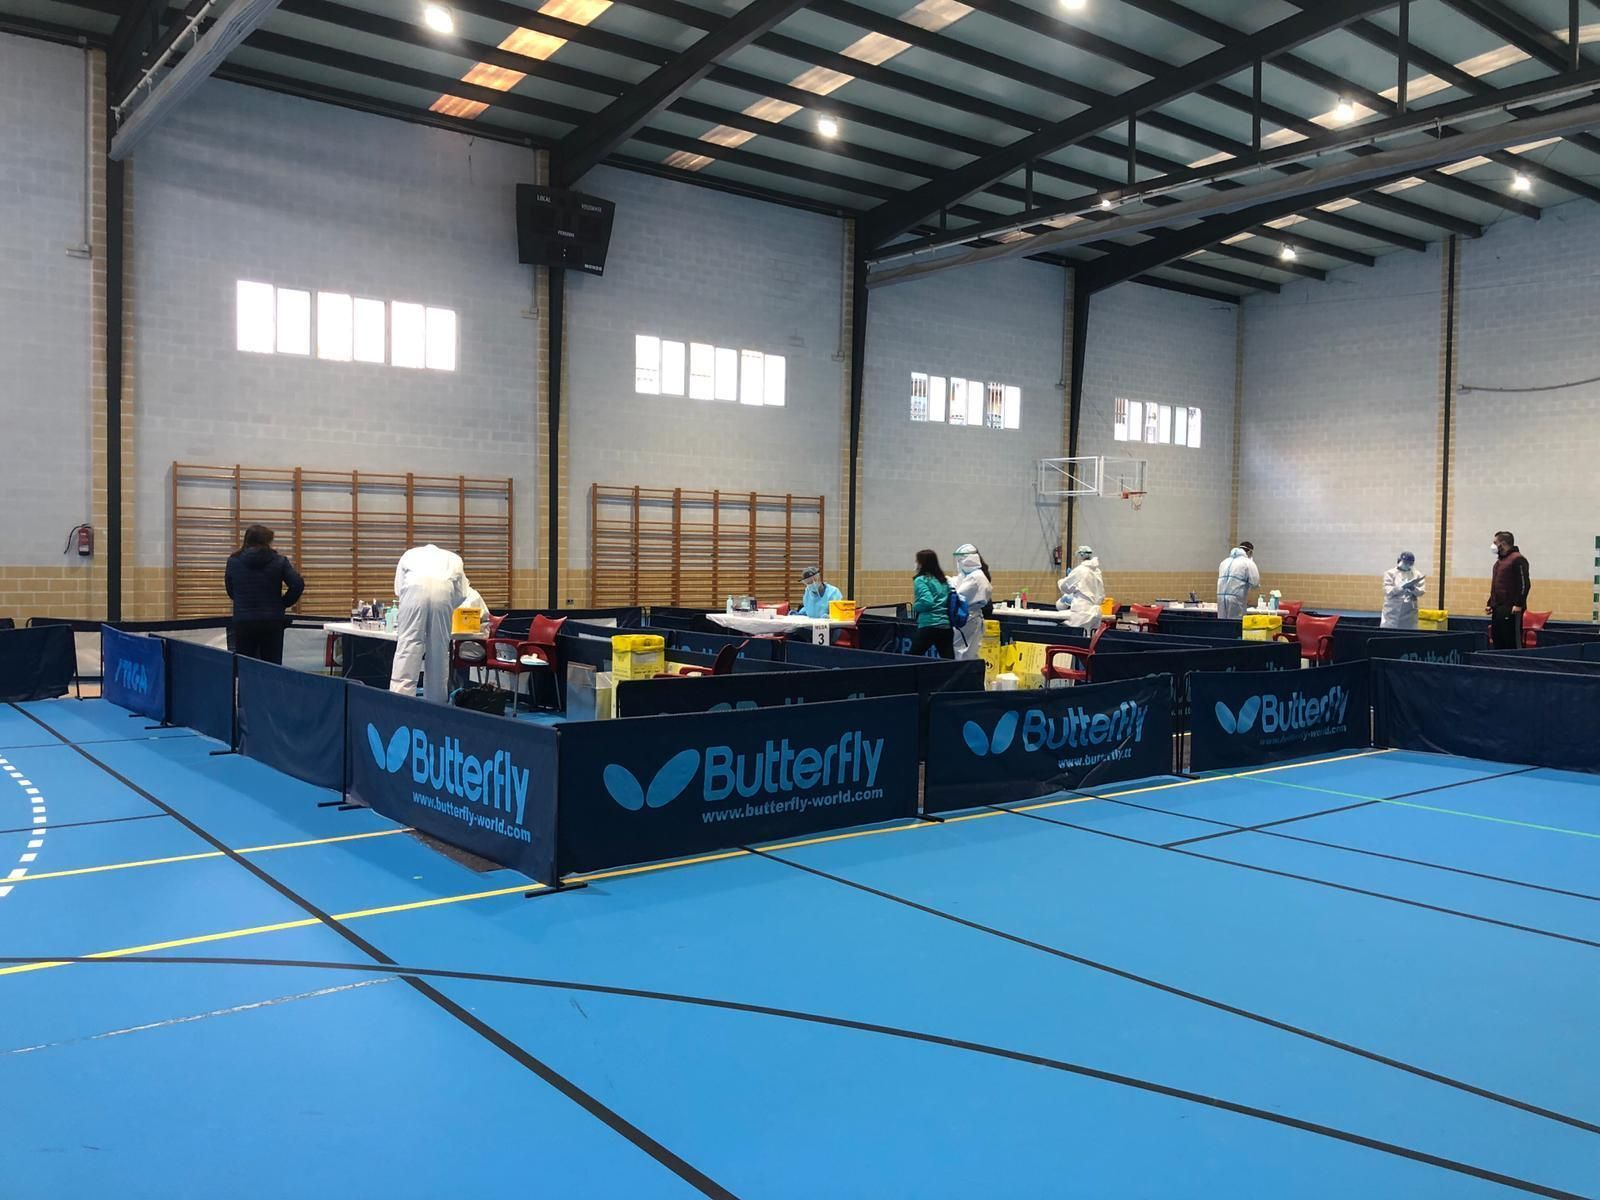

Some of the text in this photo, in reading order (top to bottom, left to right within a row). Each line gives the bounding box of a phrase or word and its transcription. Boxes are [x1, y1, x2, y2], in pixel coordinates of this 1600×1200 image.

[818, 633, 824, 645] 3
[1022, 700, 1148, 752] Butterfly
[412, 728, 529, 825] Butterfly
[703, 730, 884, 802] Butterfly
[412, 791, 531, 843] www.butterfly-world.com
[702, 787, 884, 823] www.butterfly-world.com
